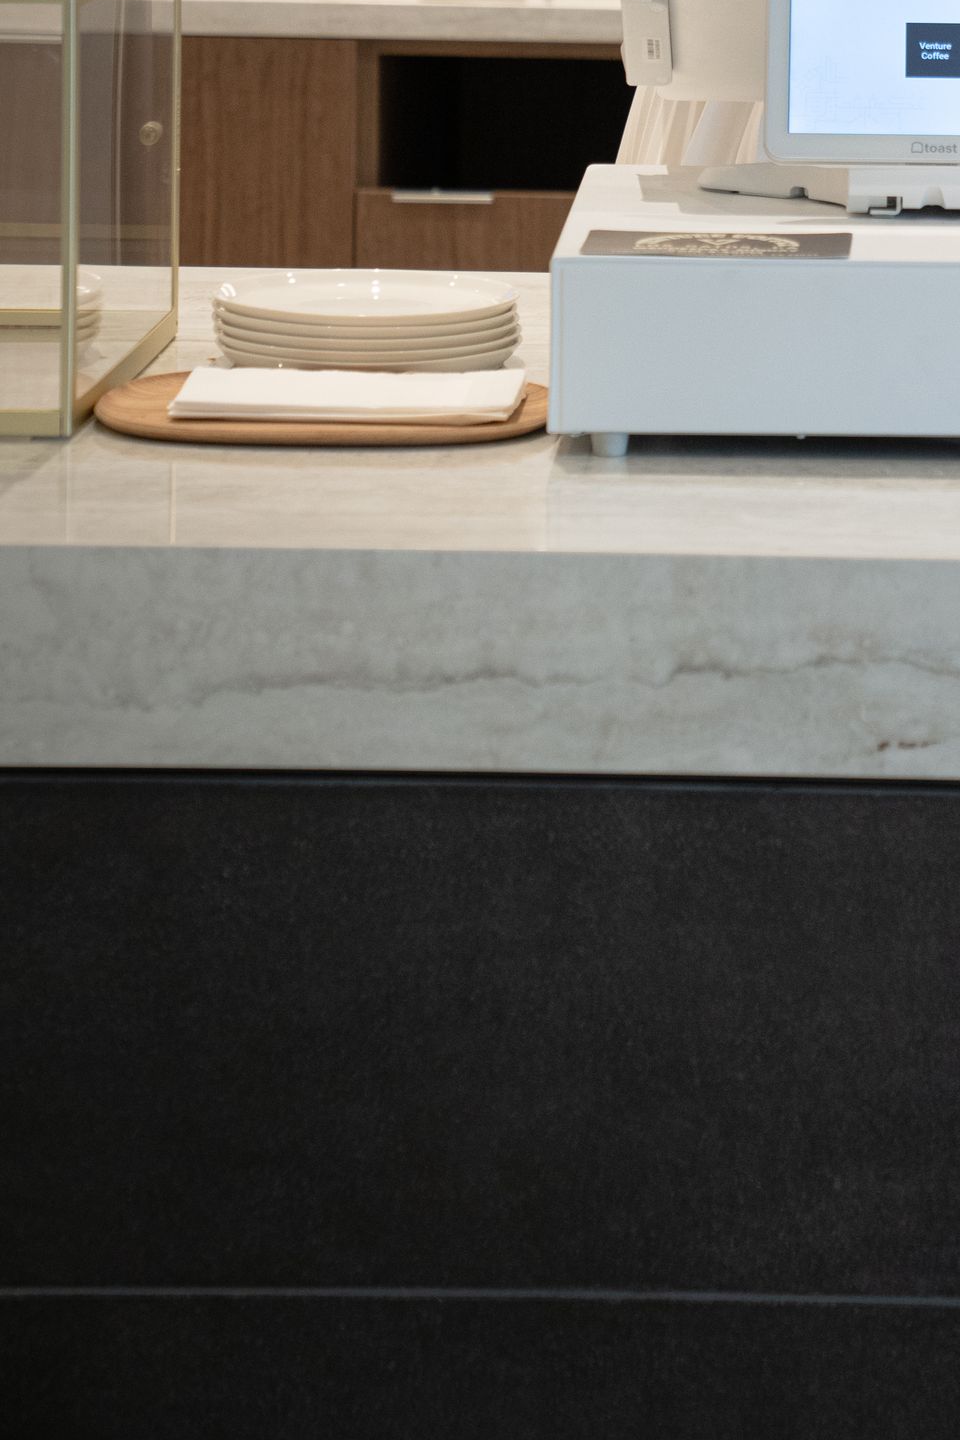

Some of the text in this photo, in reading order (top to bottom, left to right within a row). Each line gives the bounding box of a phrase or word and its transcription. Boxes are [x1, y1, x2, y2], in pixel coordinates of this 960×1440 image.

[919, 42, 952, 51] Venture
[921, 51, 950, 60] Coffee
[925, 143, 958, 154] toast
